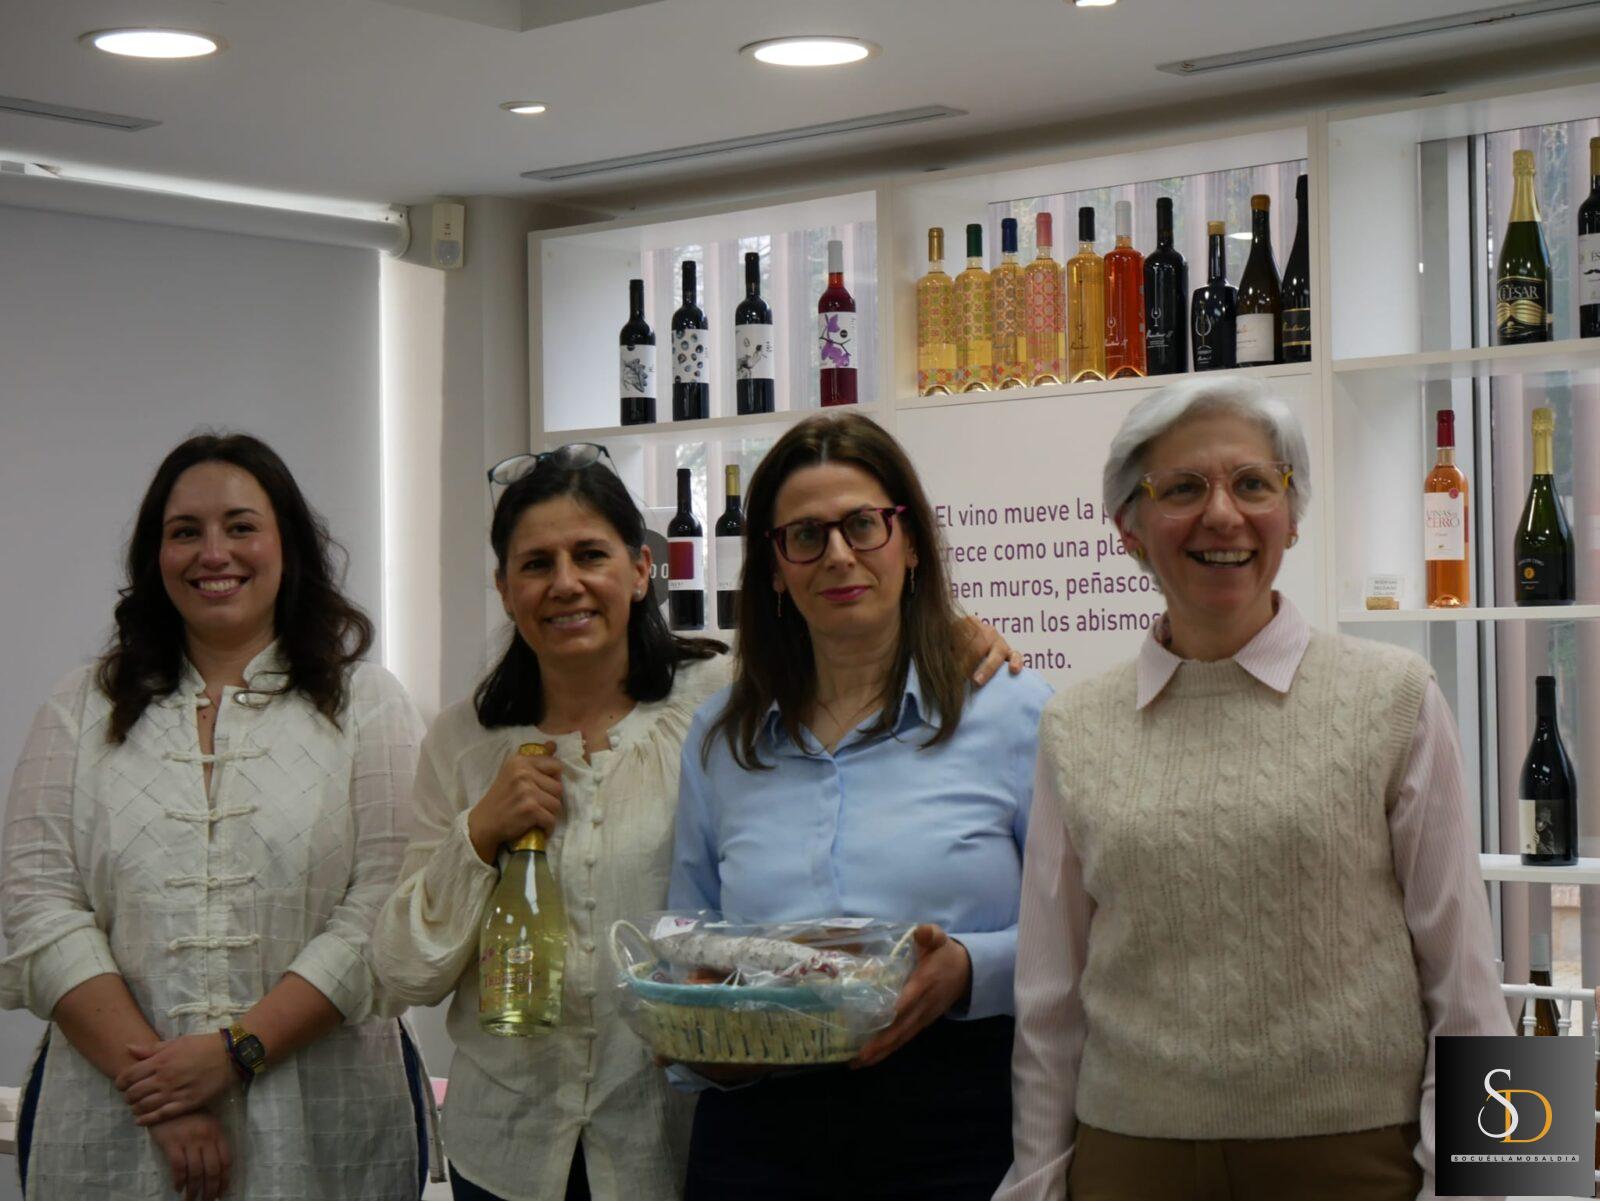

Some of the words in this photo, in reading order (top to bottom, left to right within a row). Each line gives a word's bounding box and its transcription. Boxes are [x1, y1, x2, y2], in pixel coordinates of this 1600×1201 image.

[935, 505, 953, 527] El
[958, 504, 998, 526] vino
[1004, 504, 1070, 525] mueve
[1076, 497, 1094, 519] la
[945, 544, 987, 563] rece
[994, 542, 1046, 562] como
[1053, 540, 1089, 559] una
[1096, 532, 1127, 562] pla
[951, 581, 983, 599] aen
[990, 577, 1059, 600] muros,
[975, 611, 1034, 634] rran
[1041, 609, 1070, 632] los
[1022, 648, 1072, 669] anto.
